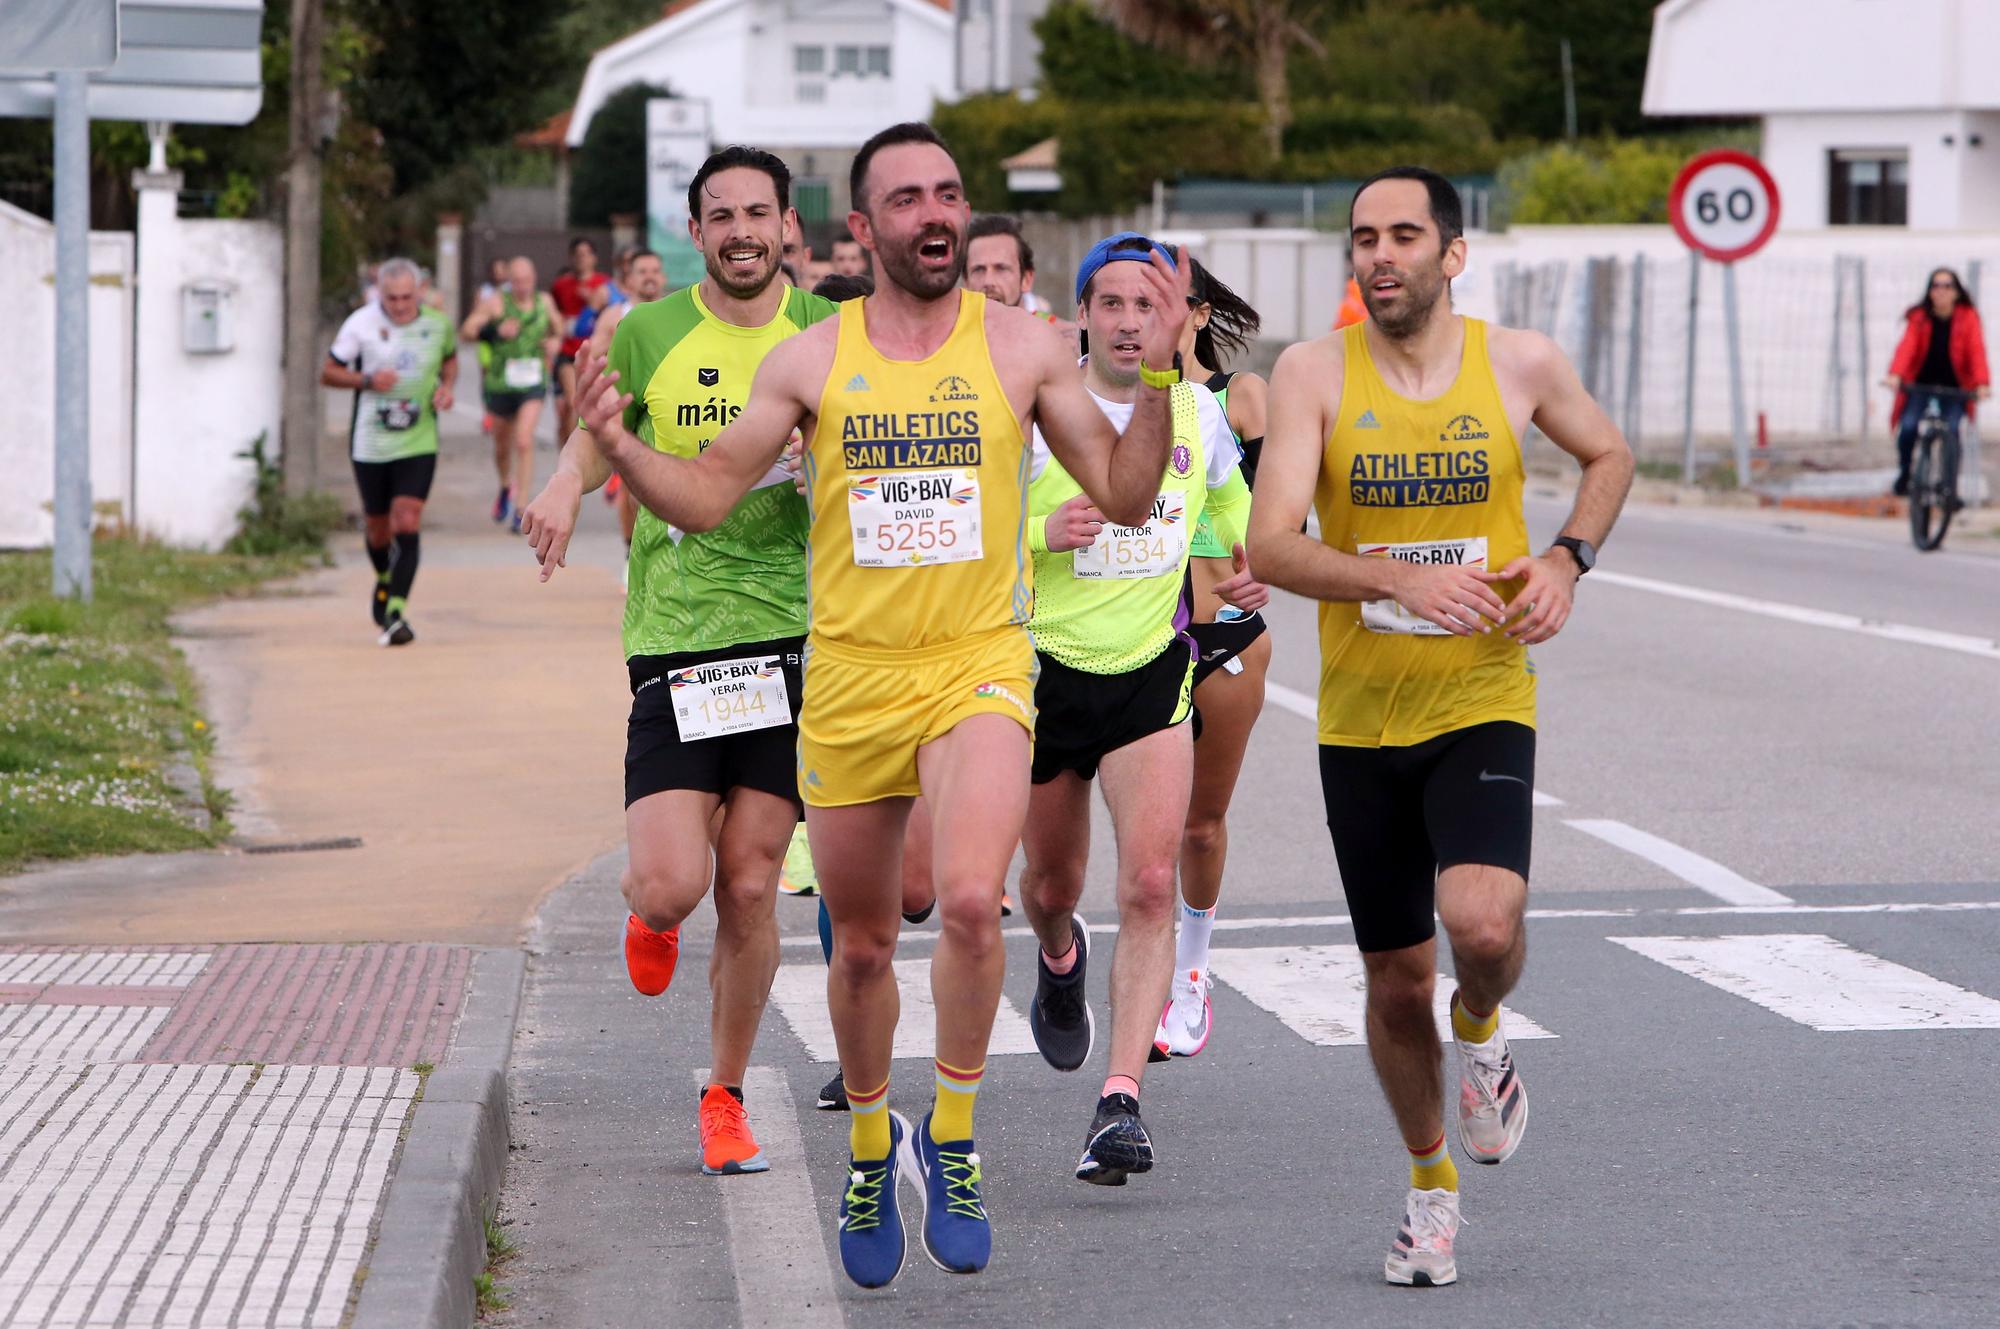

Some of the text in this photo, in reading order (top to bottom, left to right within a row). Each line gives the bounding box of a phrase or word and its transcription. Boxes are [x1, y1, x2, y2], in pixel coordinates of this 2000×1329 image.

[1697, 188, 1753, 224] 60
[842, 411, 979, 440] ATHLETICS
[1440, 432, 1489, 441] S. LAZARO
[845, 441, 979, 467] SAN LÁZARO
[1350, 450, 1488, 479] ATHLETICS
[881, 478, 953, 503] VIG BAY
[1352, 480, 1487, 505] SAN LÁZARO
[895, 508, 934, 520] DAVID
[1148, 500, 1166, 520] AY
[877, 520, 957, 552] 5255
[1112, 527, 1152, 538] VICTOR
[1099, 537, 1166, 565] 1534
[701, 595, 738, 641] auga
[730, 664, 759, 678] BAY
[711, 682, 746, 696] YERAR
[699, 690, 767, 724] 1944
